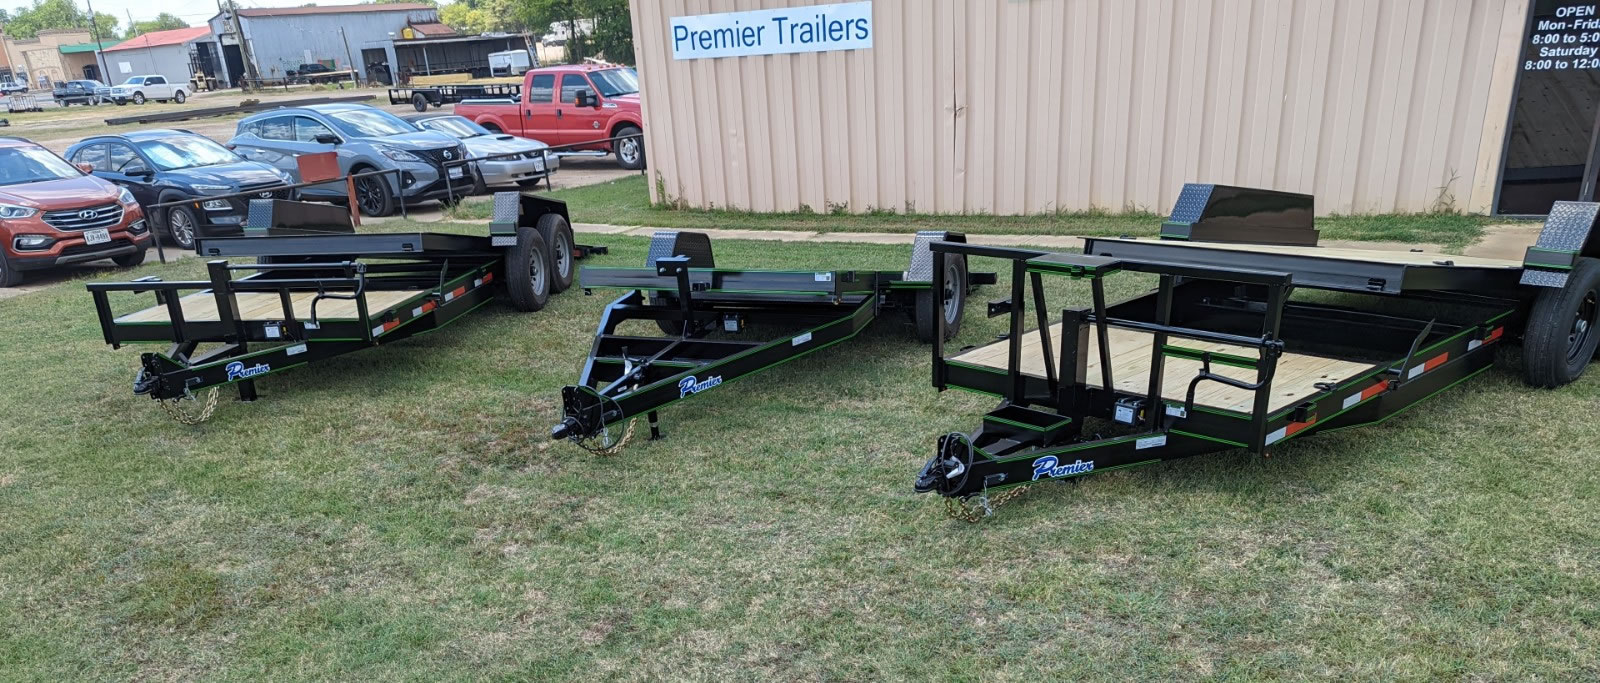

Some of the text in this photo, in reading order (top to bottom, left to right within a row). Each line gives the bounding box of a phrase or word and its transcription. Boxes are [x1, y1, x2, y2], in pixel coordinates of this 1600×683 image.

[1556, 5, 1596, 18] OPEN
[673, 13, 869, 52] Premier Trailers
[1532, 32, 1600, 44] 8:00 to 5:0
[1539, 45, 1598, 58] Saturday
[1524, 58, 1600, 70] 8:00 to 12:0
[225, 361, 271, 382] Premier
[678, 375, 723, 399] Premier
[1031, 455, 1094, 481] Premier
